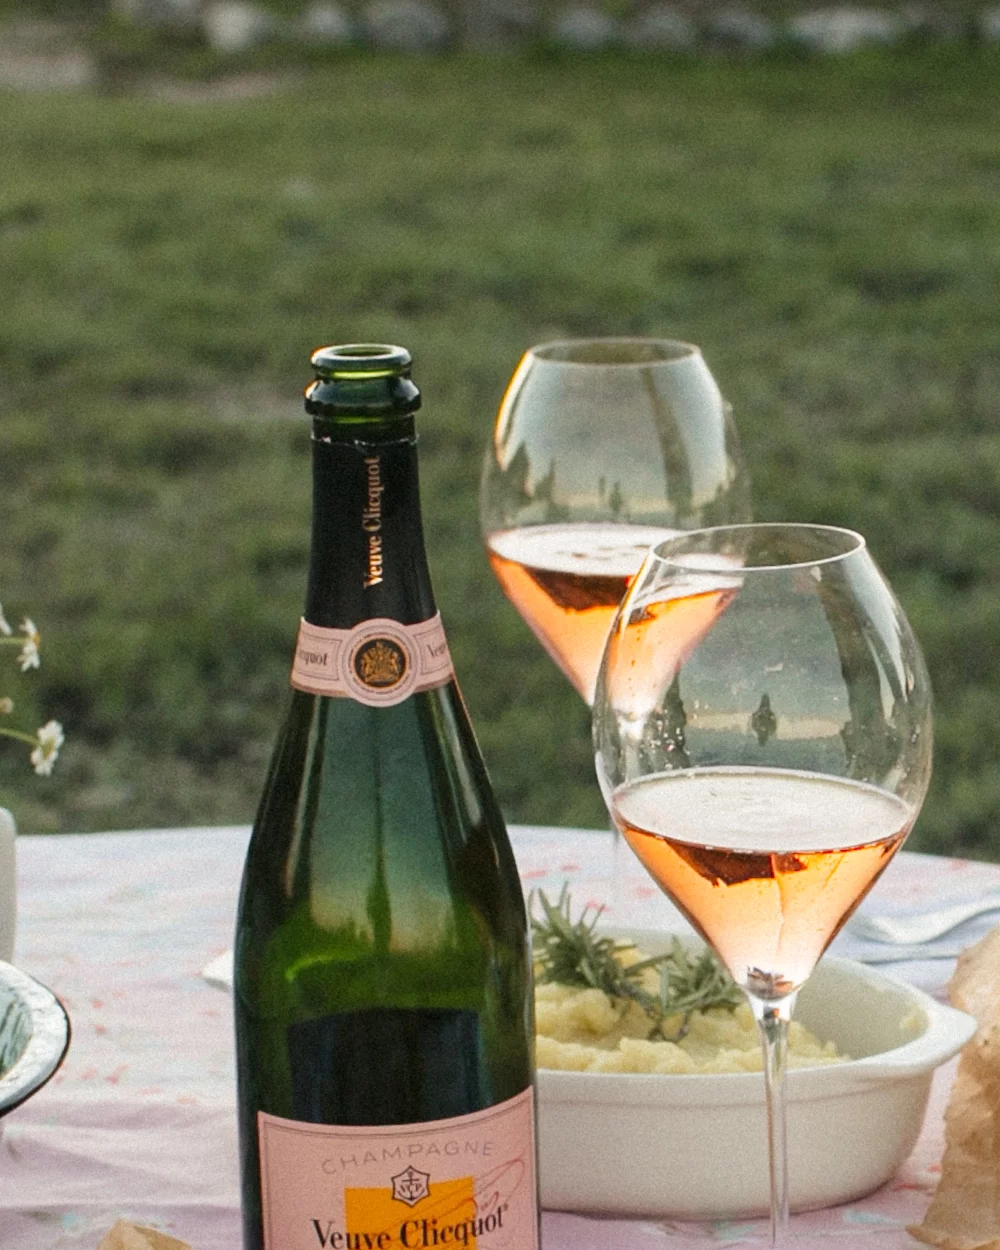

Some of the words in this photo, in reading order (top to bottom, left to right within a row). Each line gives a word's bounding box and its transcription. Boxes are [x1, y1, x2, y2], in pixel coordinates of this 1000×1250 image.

[362, 455, 384, 533] Clicquot
[363, 535, 384, 589] Veuve
[321, 1140, 496, 1175] CHAMPAGNE
[311, 1218, 391, 1250] Veuve
[400, 1205, 504, 1249] Clicquot
